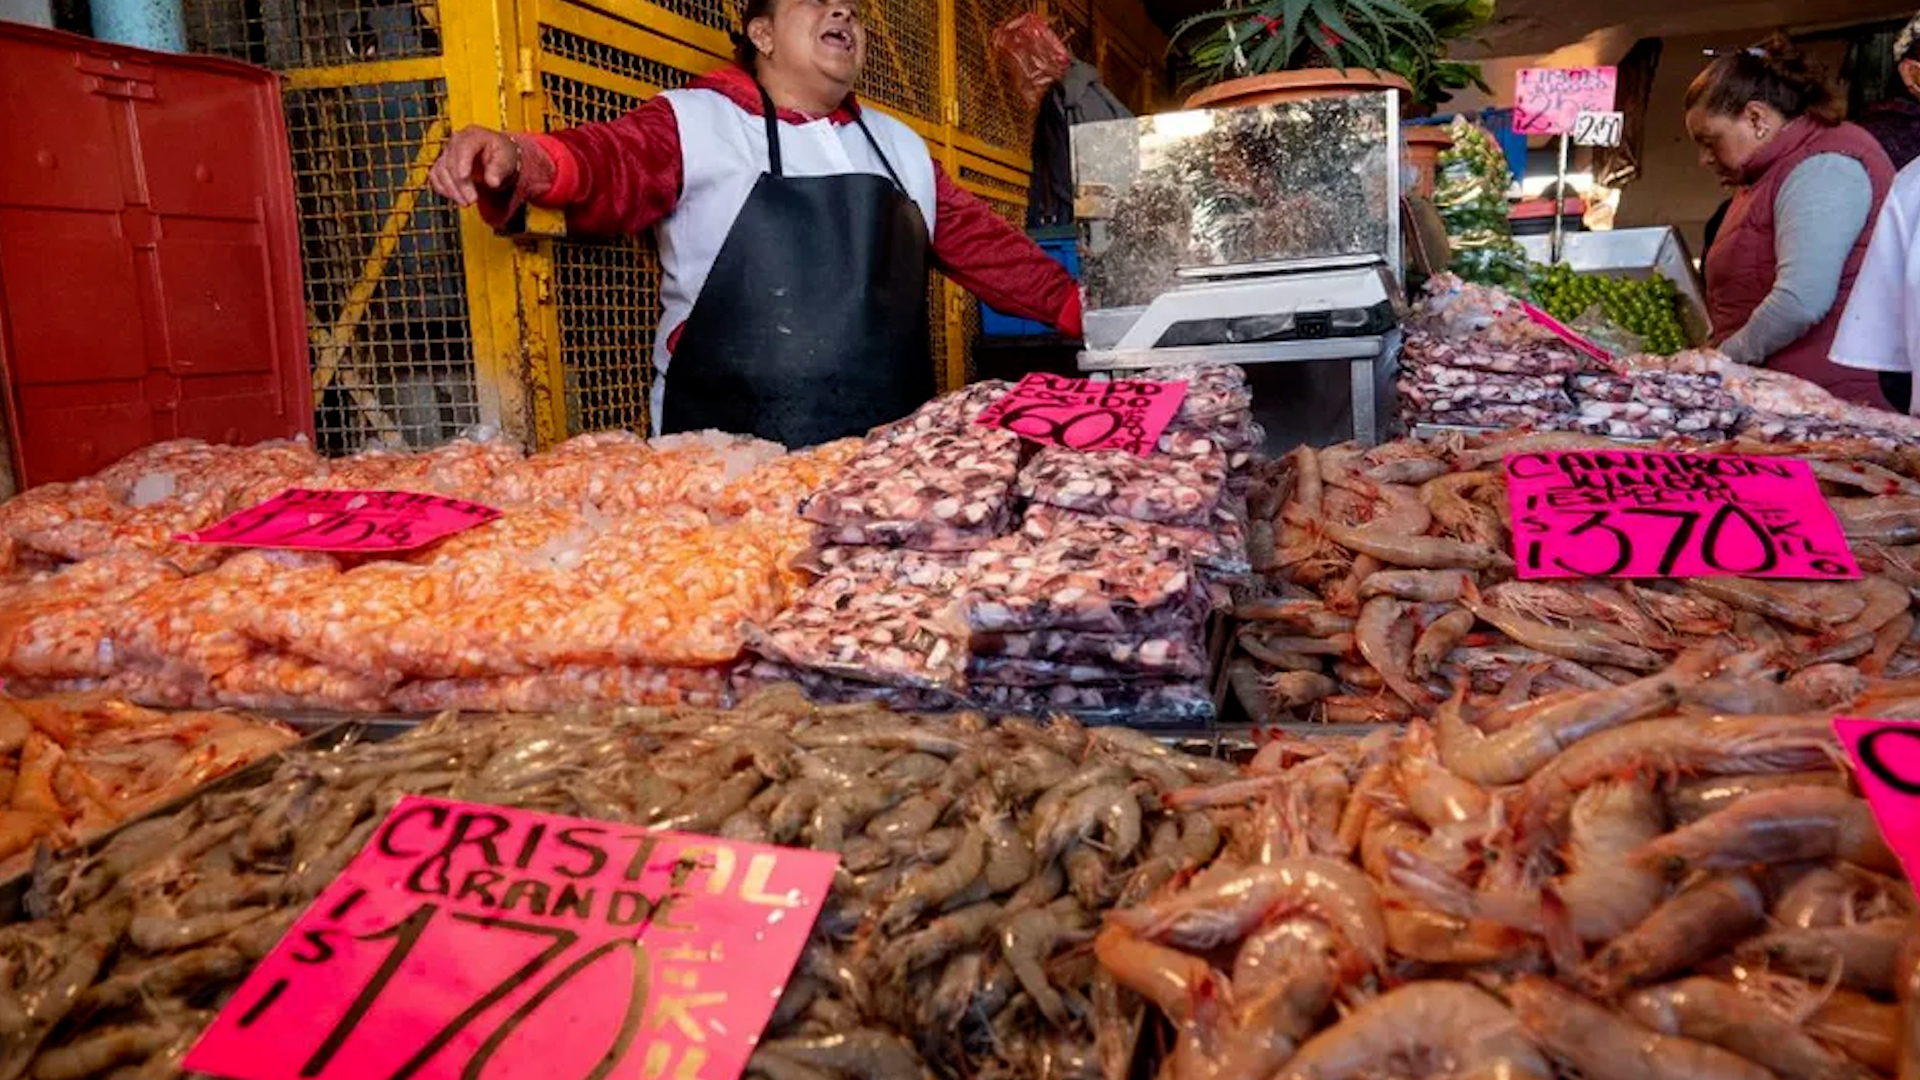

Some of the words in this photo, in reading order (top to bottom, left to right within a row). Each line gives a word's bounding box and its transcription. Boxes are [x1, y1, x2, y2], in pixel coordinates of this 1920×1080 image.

[1020, 374, 1162, 396] PULPO
[378, 804, 800, 907] CRISTAL
[403, 856, 698, 932] GRANDE
